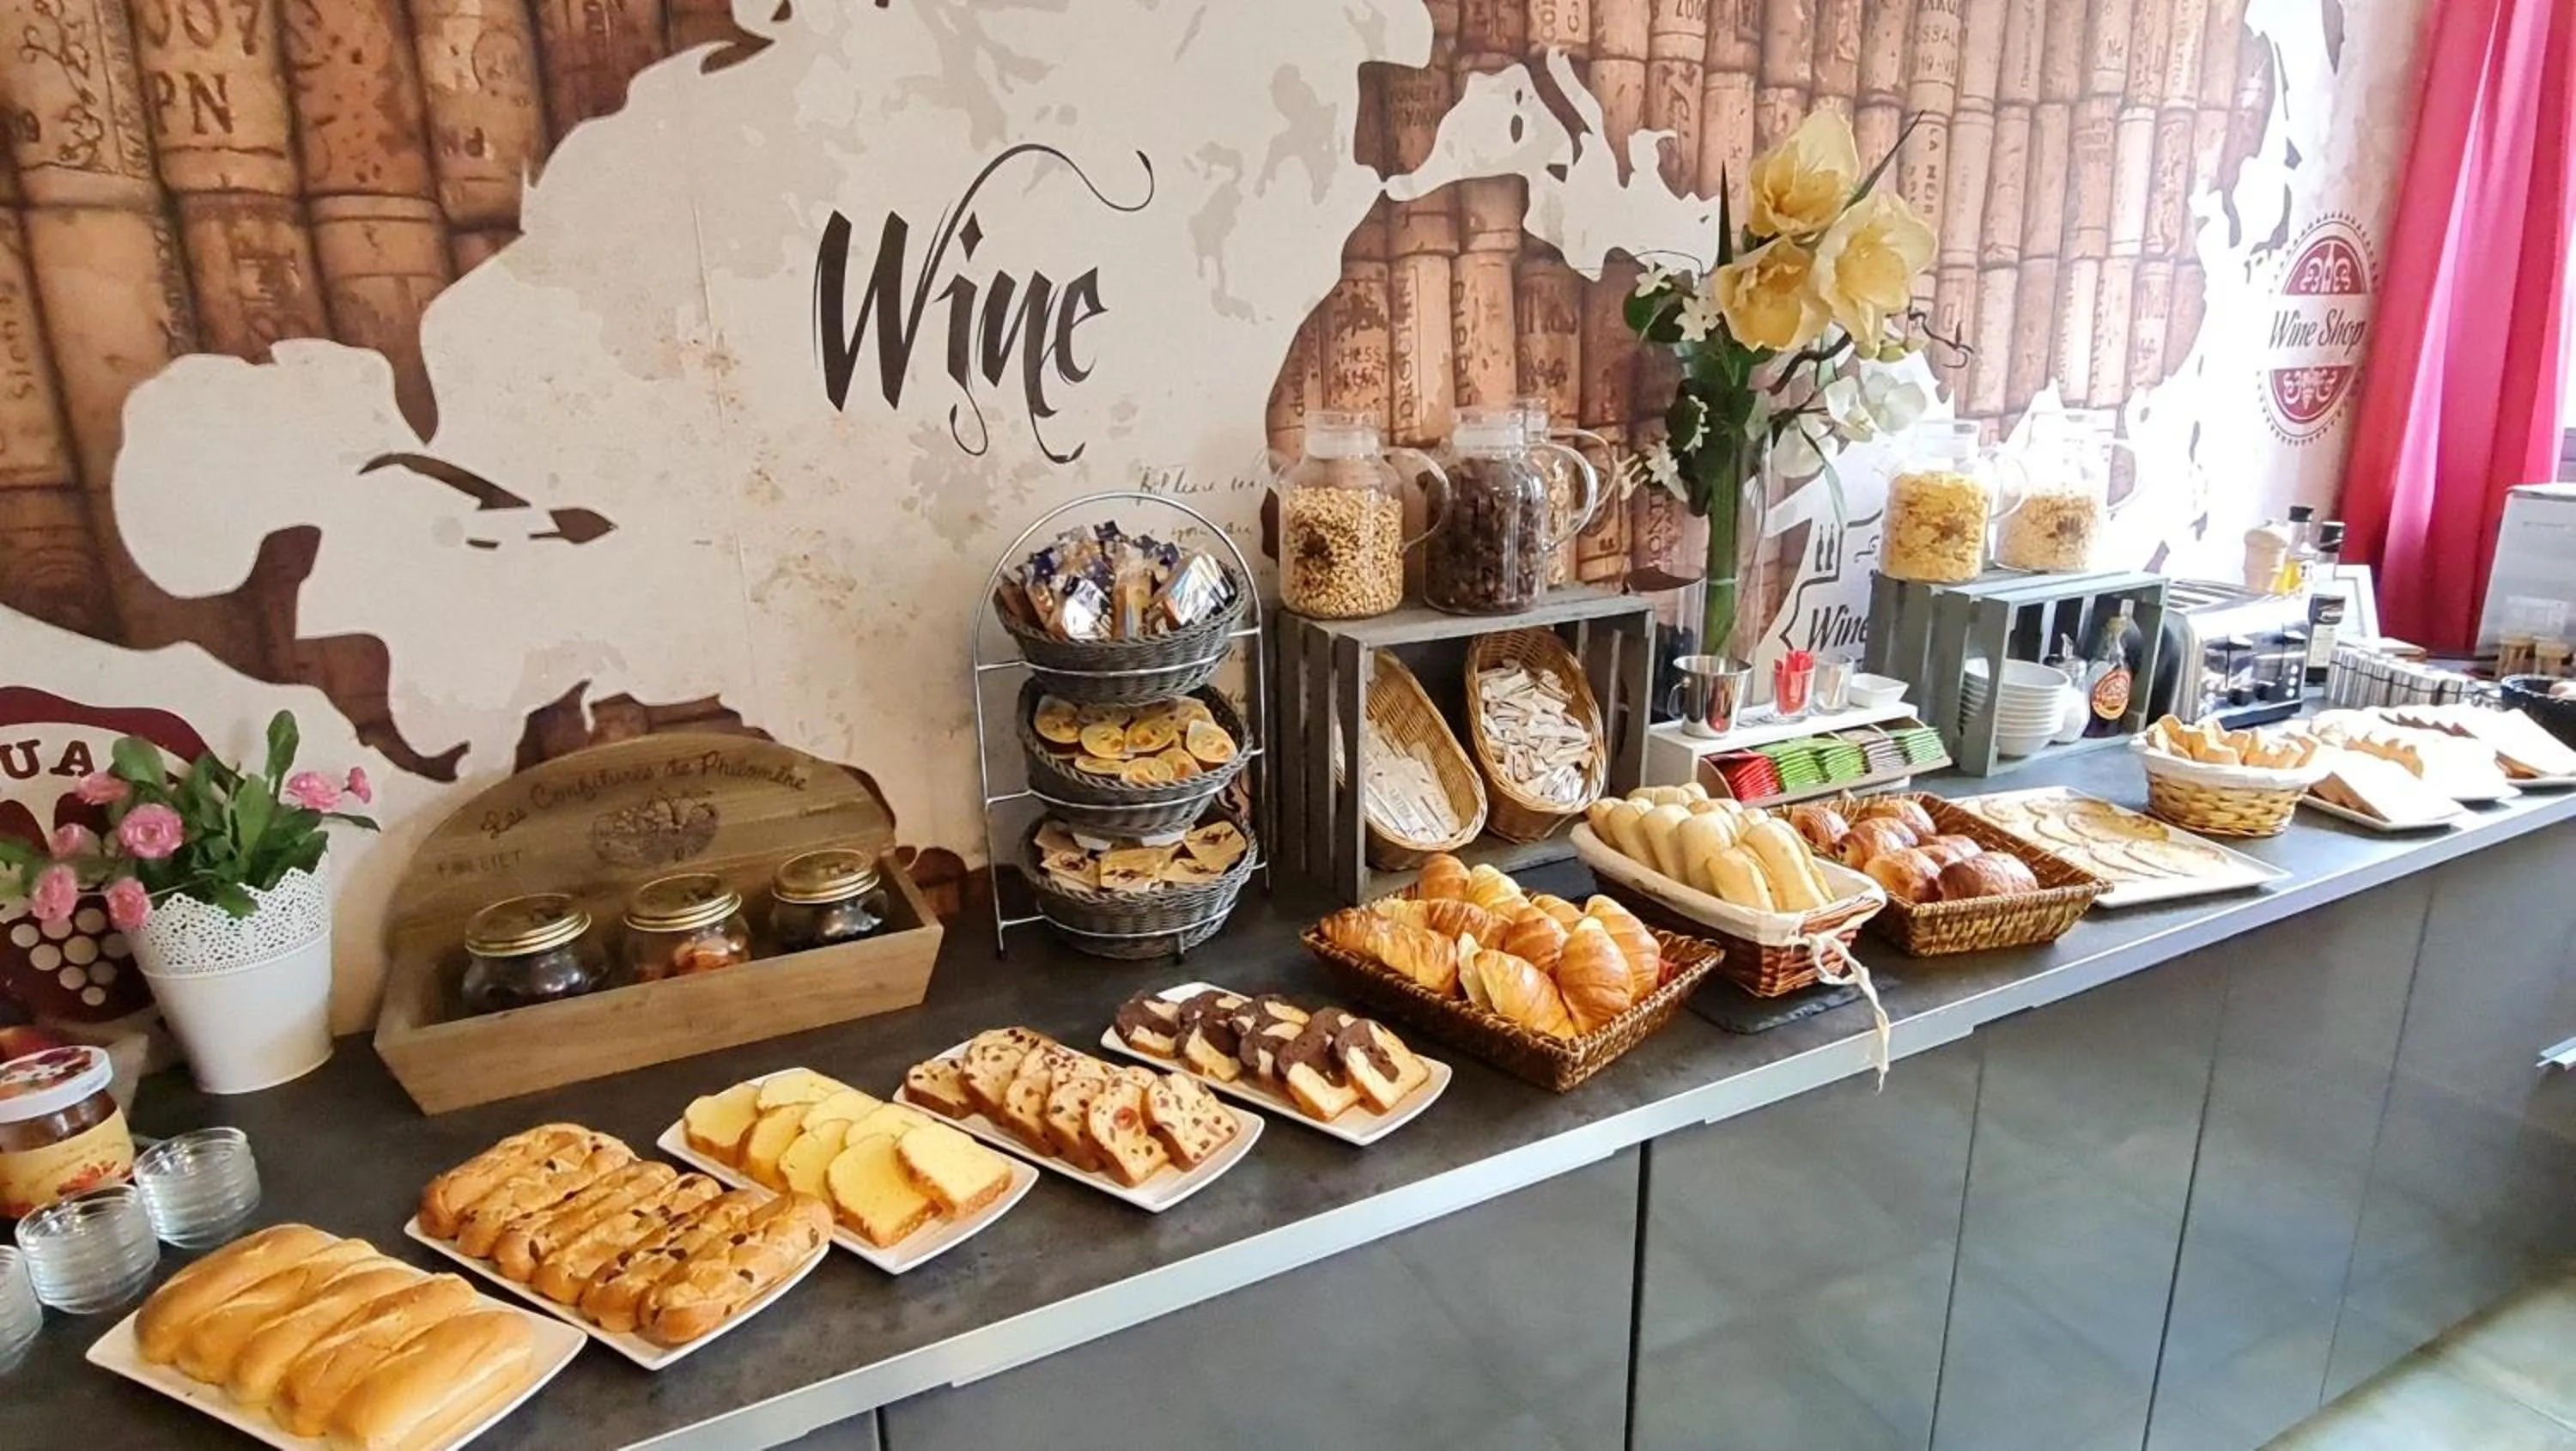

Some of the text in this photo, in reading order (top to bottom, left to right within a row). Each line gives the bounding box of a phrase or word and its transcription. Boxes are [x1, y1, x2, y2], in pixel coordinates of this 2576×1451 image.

[811, 143, 1155, 464] Wine
[2269, 307, 2366, 356] Wine Shop
